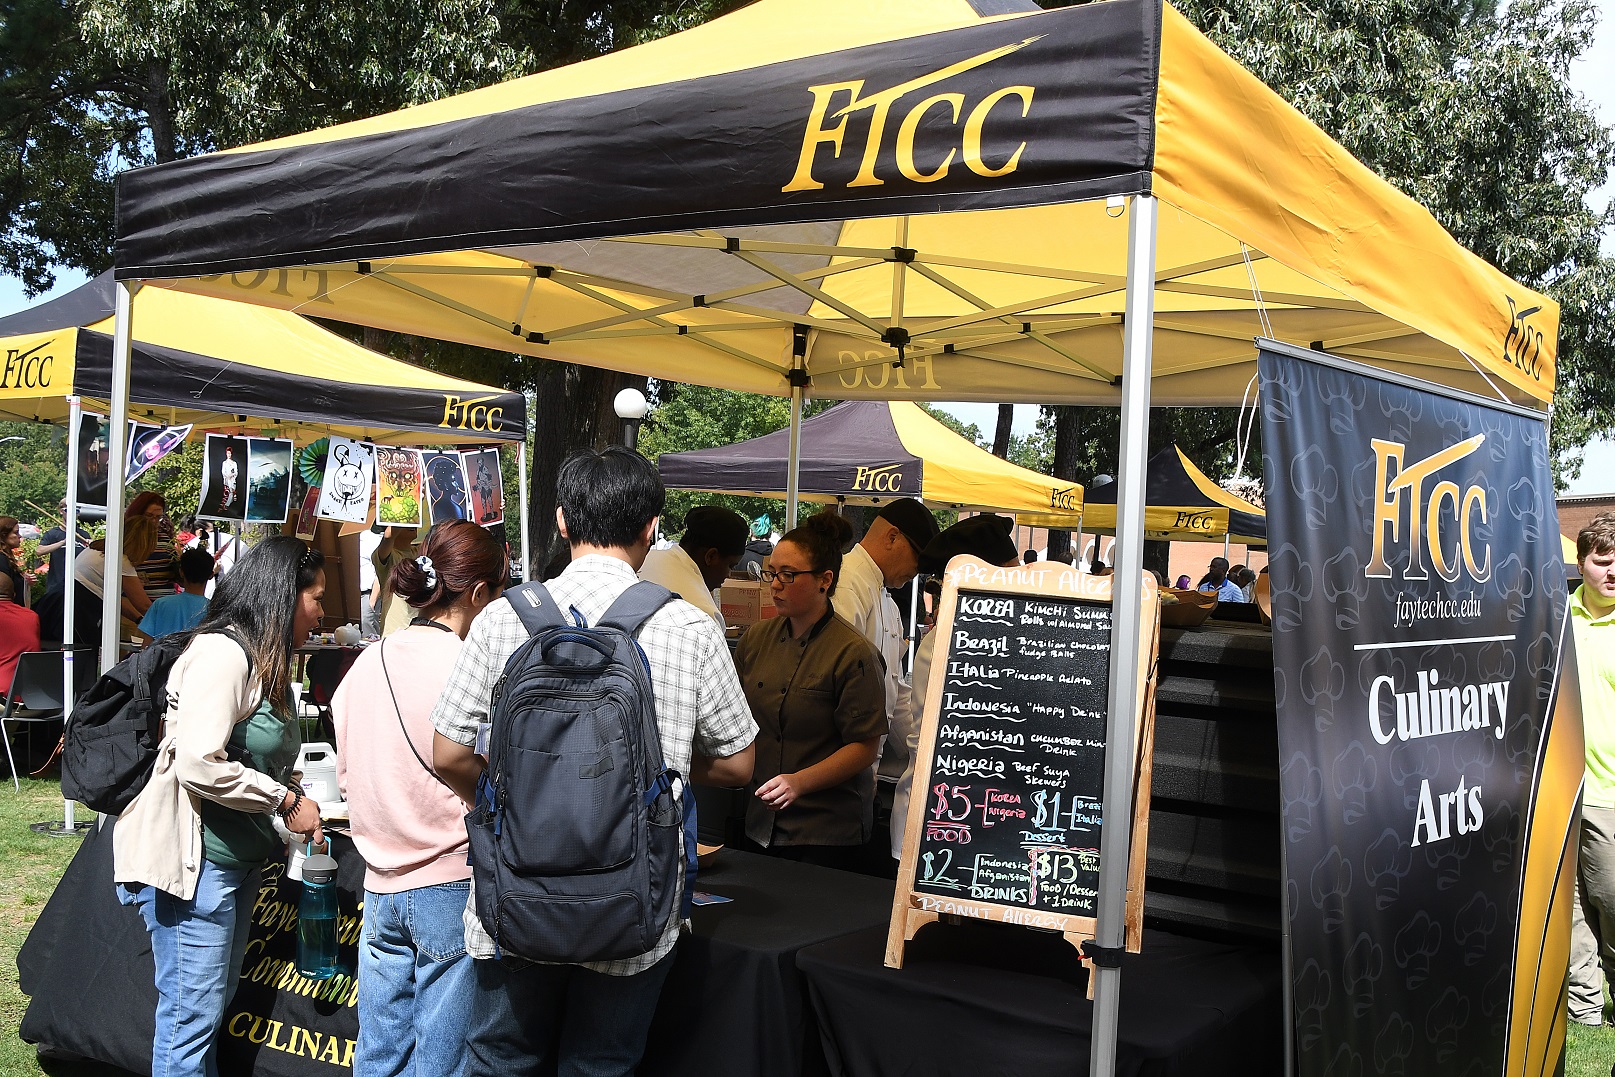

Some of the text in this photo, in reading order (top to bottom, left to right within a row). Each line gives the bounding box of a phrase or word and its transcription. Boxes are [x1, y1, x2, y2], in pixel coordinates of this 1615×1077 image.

[782, 34, 1049, 193] FTCC
[1503, 294, 1543, 381] FTCC
[0, 338, 57, 388] FTCC
[437, 394, 503, 432] FTCC
[851, 463, 904, 492] FTCC
[1050, 487, 1075, 510] FTCC
[1365, 433, 1491, 584] FTCC
[1172, 509, 1213, 529] FTCC
[960, 596, 1015, 618] KOREA
[1394, 591, 1482, 628] faytechcc.edu
[1368, 668, 1510, 745] Culinary
[931, 782, 972, 821] $5
[1030, 789, 1067, 831] $1
[1410, 775, 1484, 847] Arts
[926, 827, 972, 844] FOOD
[922, 848, 959, 883] $2
[1036, 852, 1078, 884] $13
[1080, 864, 1101, 873] Valu
[967, 886, 1028, 903] DRINKS
[1069, 883, 1099, 898] Desser
